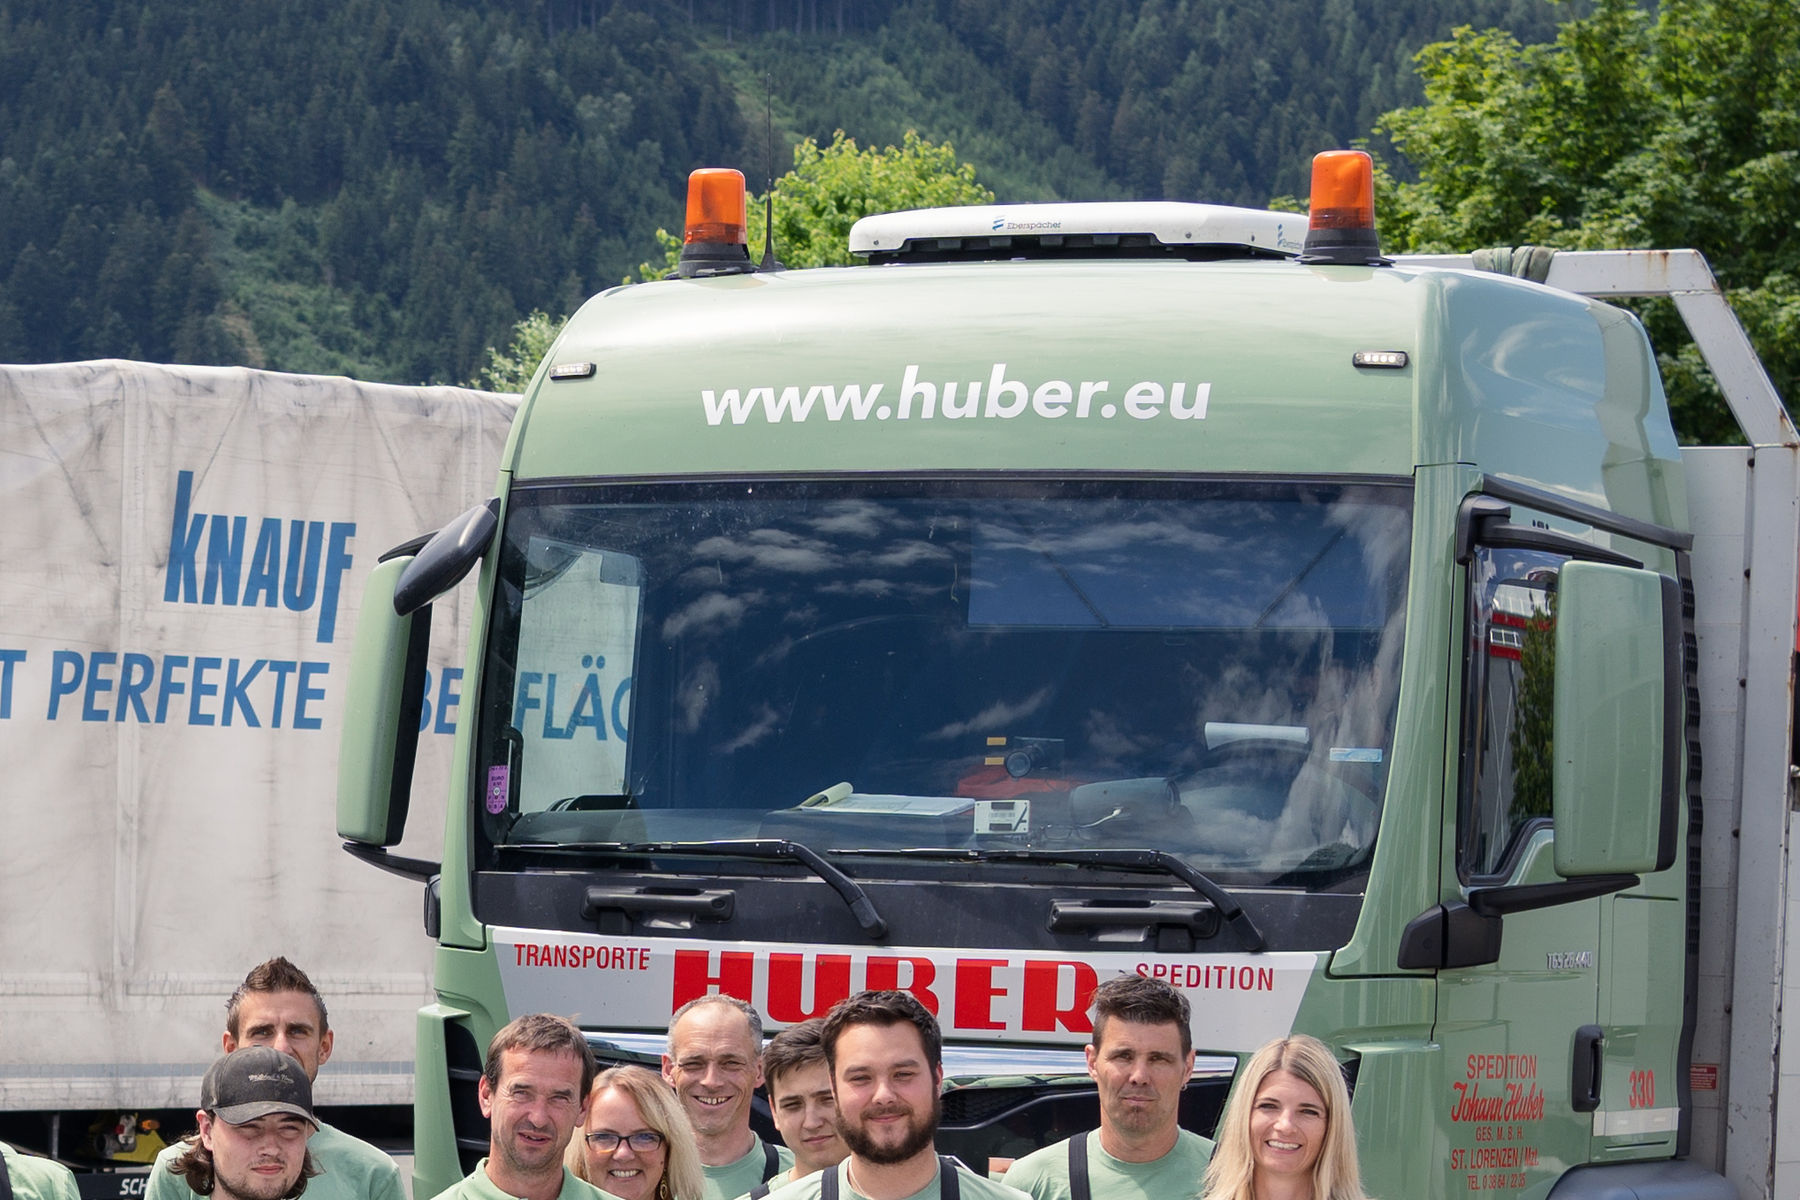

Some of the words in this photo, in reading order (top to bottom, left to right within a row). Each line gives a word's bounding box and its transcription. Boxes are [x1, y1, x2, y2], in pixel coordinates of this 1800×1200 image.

[701, 363, 1213, 426] www.huber.eu
[47, 649, 331, 731] PERFEKTE
[513, 943, 651, 971] TRANSPORTE
[672, 948, 1098, 1034] HUBER
[1135, 962, 1274, 991] SPEDITION
[1466, 1053, 1538, 1080] SPEDITION
[1450, 1081, 1504, 1123] Johann
[1503, 1081, 1545, 1123] Huber
[1629, 1069, 1655, 1108] 330
[1451, 1148, 1468, 1170] ST.
[1470, 1147, 1519, 1169] LORENZEN
